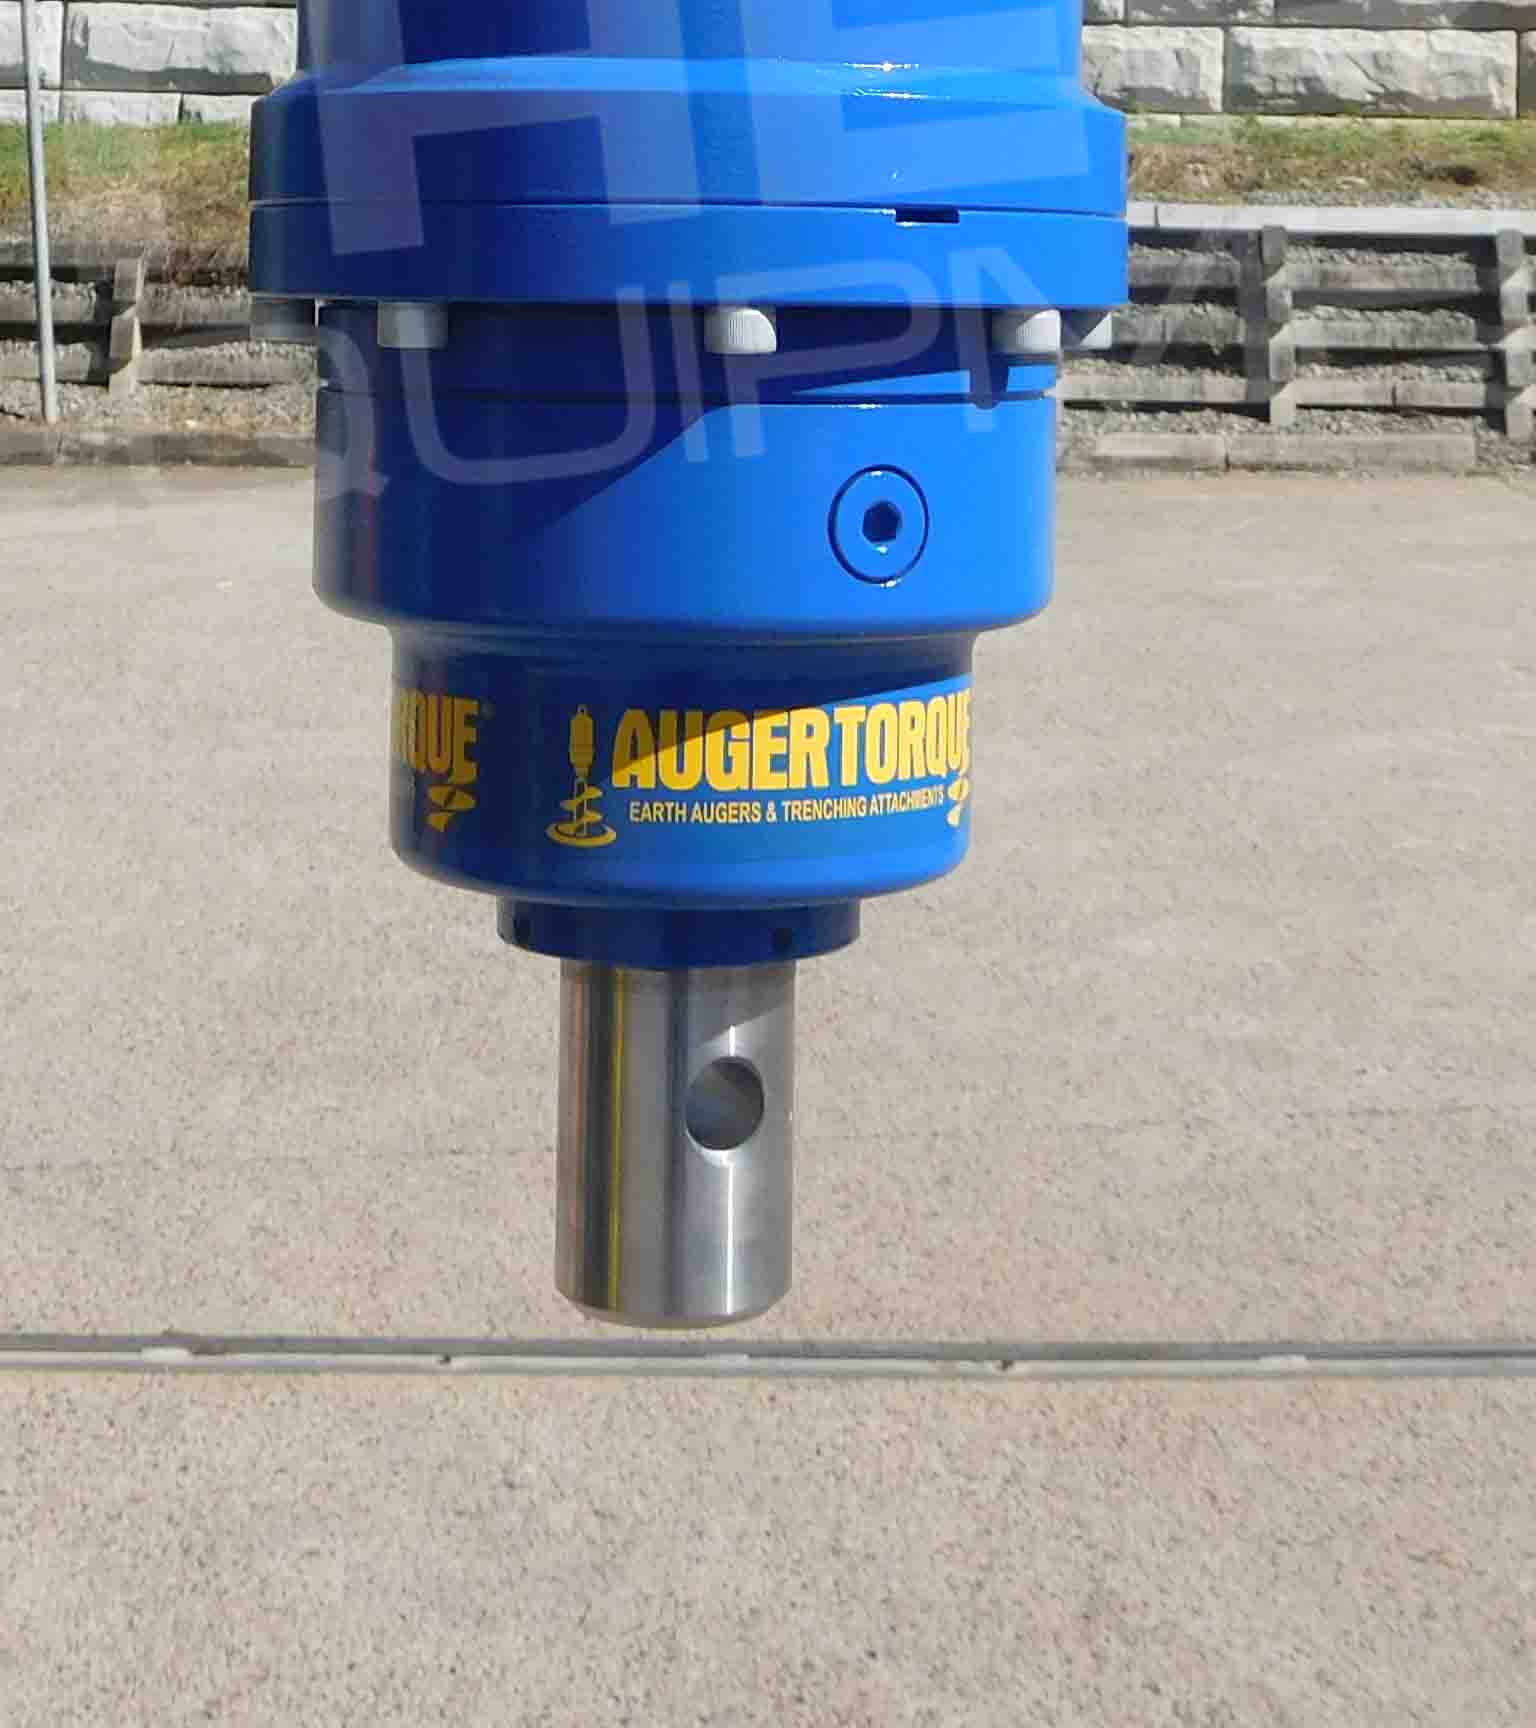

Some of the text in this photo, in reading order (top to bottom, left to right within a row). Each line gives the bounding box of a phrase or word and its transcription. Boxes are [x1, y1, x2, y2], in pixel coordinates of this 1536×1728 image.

[612, 688, 972, 793] AUGERTORQUE
[629, 800, 688, 824] EARTH
[691, 801, 762, 824] AUGERS
[765, 801, 778, 822] &
[781, 794, 867, 822] TRENCHING
